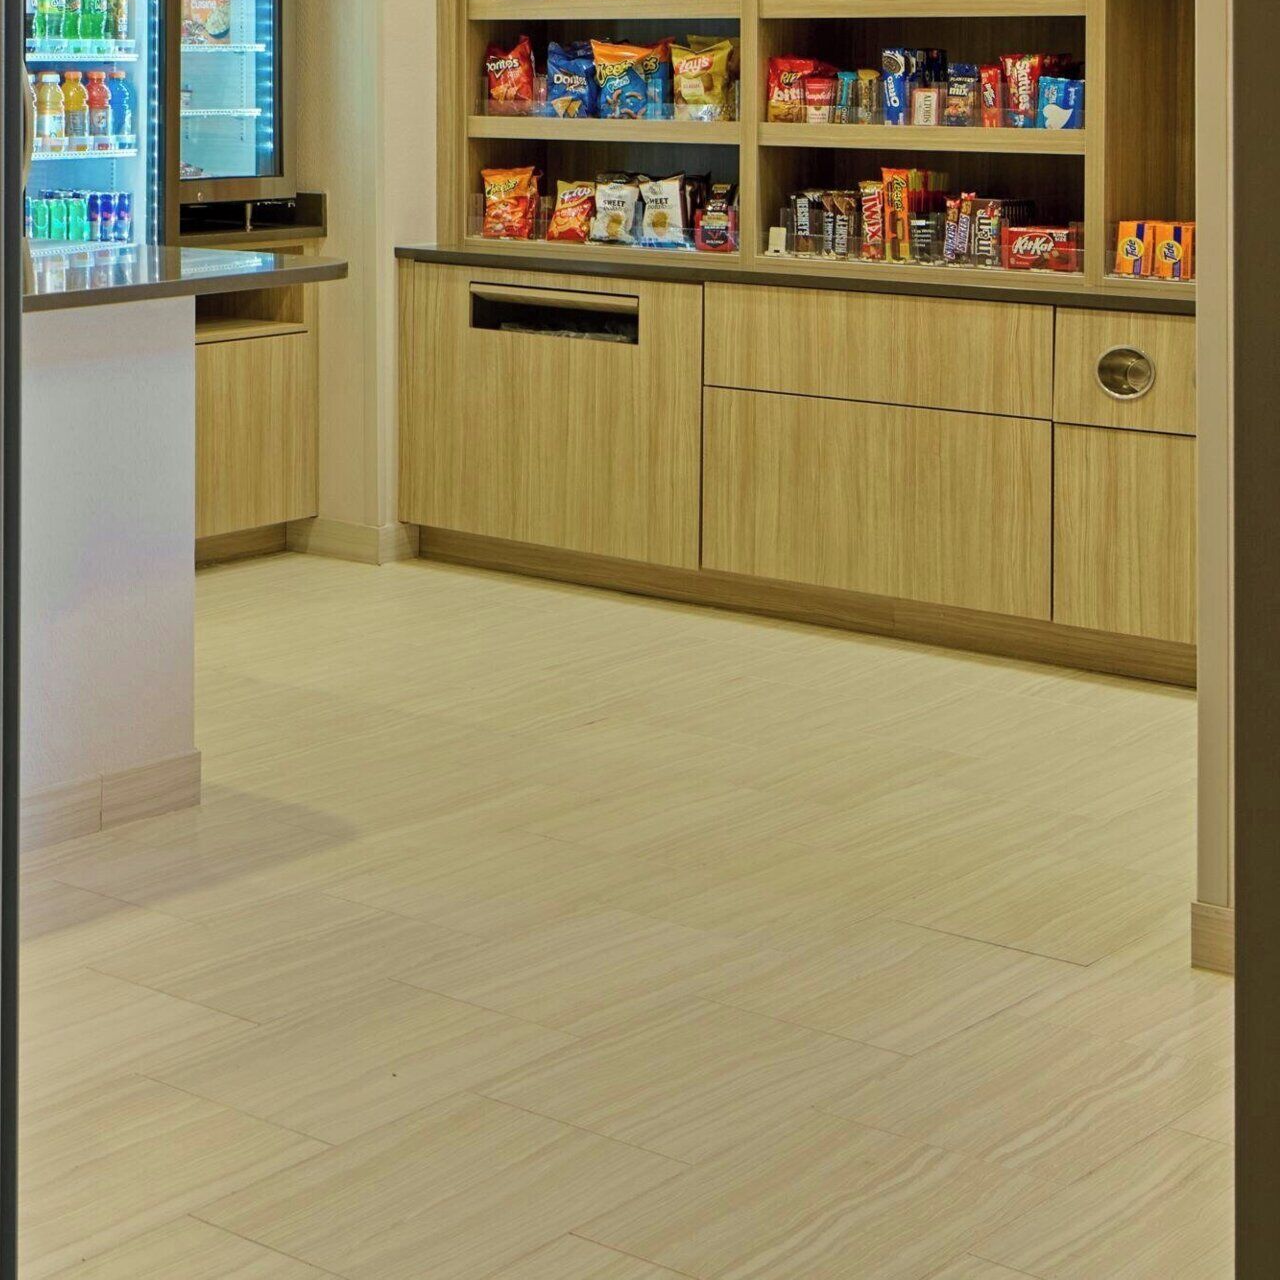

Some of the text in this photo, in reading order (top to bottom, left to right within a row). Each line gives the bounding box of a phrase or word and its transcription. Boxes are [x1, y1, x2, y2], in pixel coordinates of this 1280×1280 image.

[887, 76, 900, 107] OREO
[1015, 60, 1031, 111] Skittles
[923, 94, 932, 123] ALTOIDS
[603, 200, 626, 208] SWEET
[861, 189, 883, 245] TWIX
[944, 221, 958, 259] SNICKERS
[956, 214, 970, 253] SNICKERS
[1125, 239, 1140, 258] Tide
[1163, 242, 1178, 261] Tide
